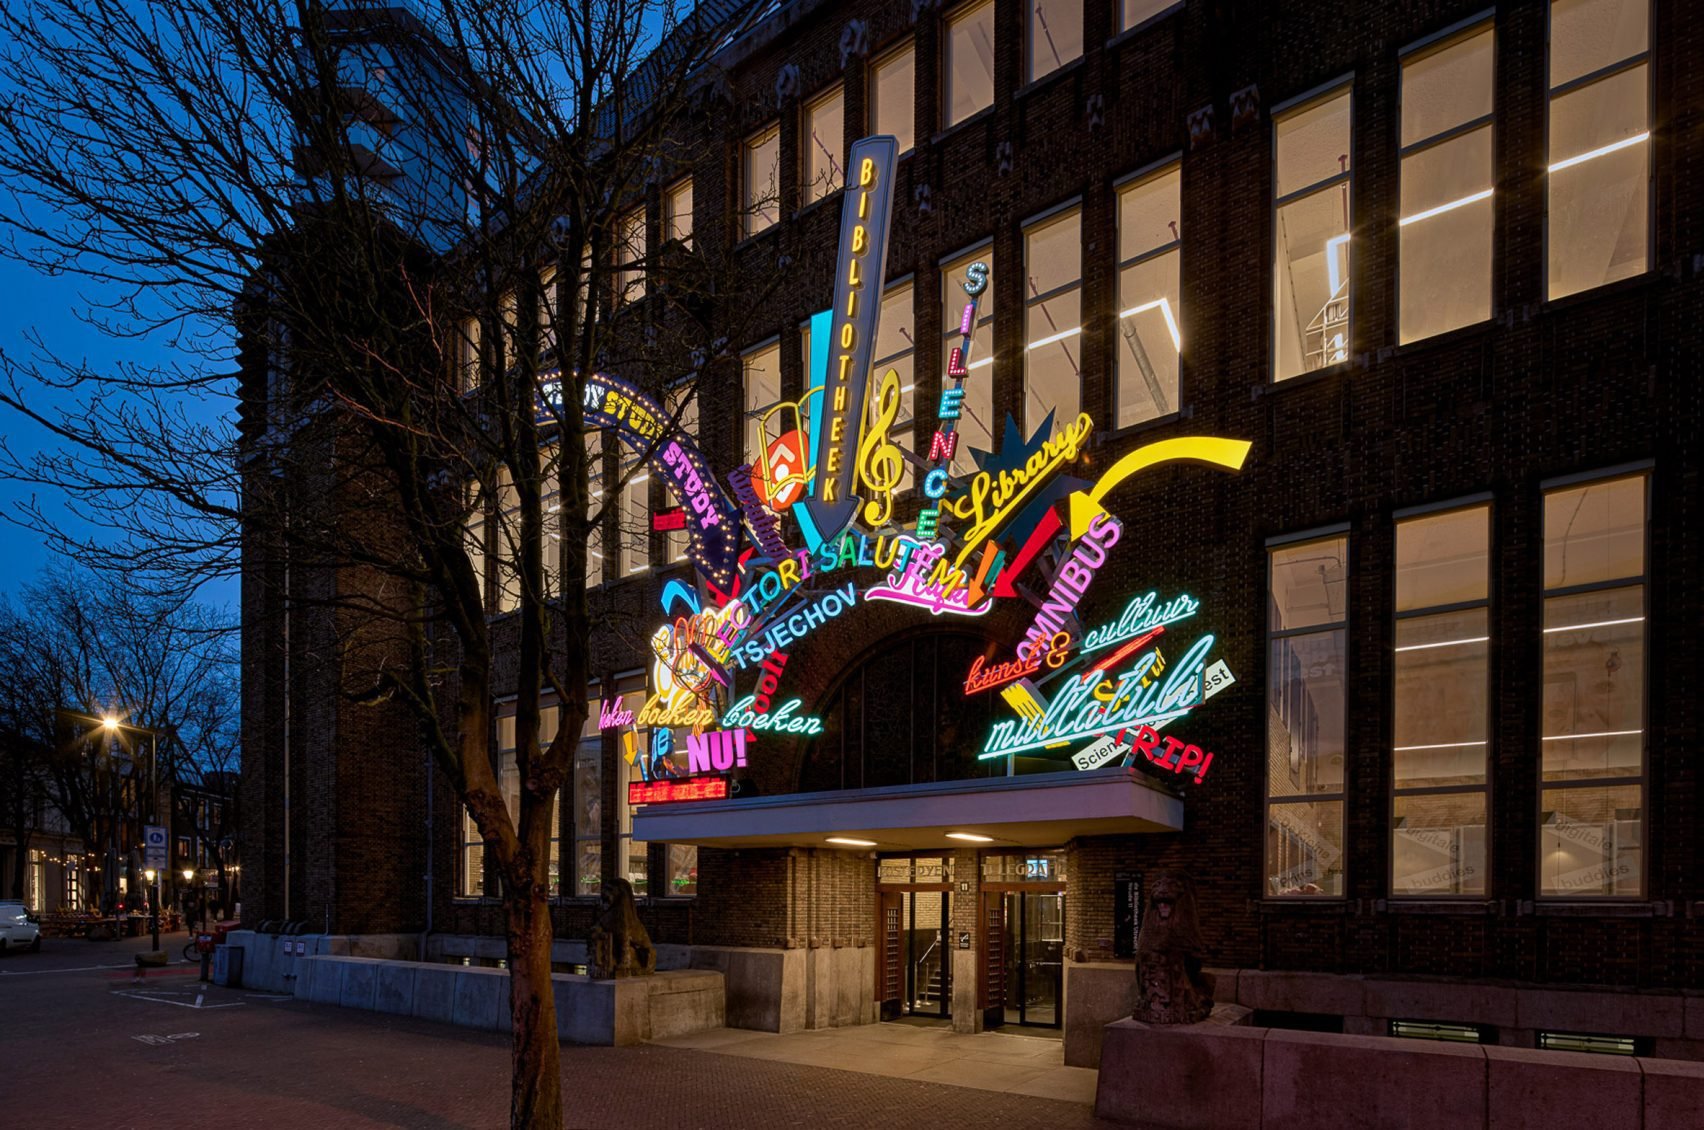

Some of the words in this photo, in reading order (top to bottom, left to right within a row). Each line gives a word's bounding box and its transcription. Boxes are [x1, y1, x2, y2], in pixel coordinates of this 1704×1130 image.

[823, 158, 876, 502] BIBLIOTHEEK
[916, 261, 989, 538] SILENCE
[662, 441, 720, 530] STUDY
[953, 413, 1093, 541] Library
[820, 535, 965, 599] SALUTEM
[1017, 513, 1122, 665] OMNIBUS
[731, 582, 858, 669] TSJECHOV
[965, 633, 1047, 691] kunst
[1046, 631, 1070, 668] &
[1084, 591, 1199, 650] cultuur
[637, 692, 713, 726] boeken
[722, 696, 822, 735] boeken
[984, 634, 1215, 754] multatuli
[686, 727, 747, 774] NU!
[1411, 866, 1474, 887] buddies
[1560, 864, 1629, 888] buddies
